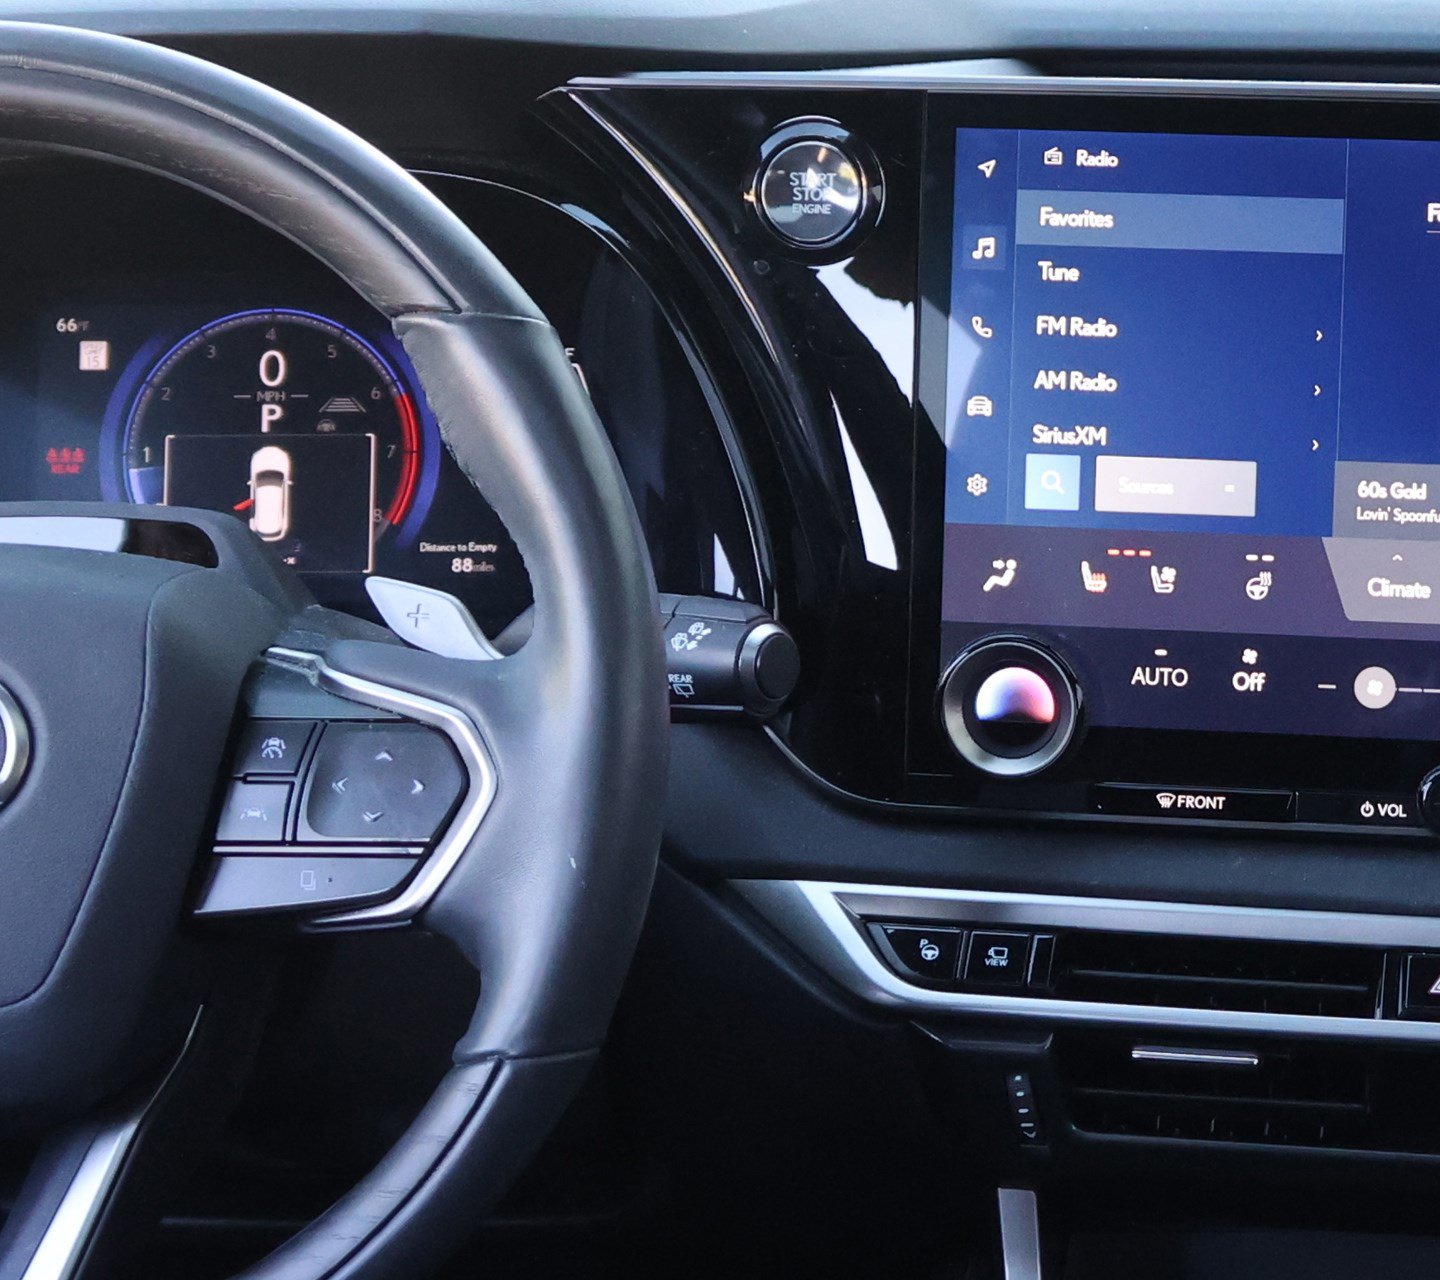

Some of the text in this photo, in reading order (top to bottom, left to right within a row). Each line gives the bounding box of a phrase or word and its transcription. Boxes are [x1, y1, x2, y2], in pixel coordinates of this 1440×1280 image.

[1076, 149, 1119, 169] Radio
[789, 171, 837, 187] STRT
[792, 203, 832, 214] ENGINE
[1039, 207, 1114, 230] Favorites
[1038, 261, 1080, 283] Tune
[265, 327, 277, 340] 4
[1036, 317, 1118, 338] FM Radio
[207, 344, 217, 359] 3
[327, 344, 337, 358] 5
[259, 349, 287, 388] 0
[1034, 371, 1118, 393] AM Radio
[161, 387, 172, 402] 2
[256, 390, 286, 403] MPH
[370, 386, 381, 400] 6
[261, 403, 284, 433] P
[1032, 425, 1107, 447] SiriusXM
[143, 446, 151, 464] 1
[387, 445, 396, 460] 7
[1357, 480, 1427, 500] 60s Gold
[419, 541, 498, 554] Distance to Empty
[451, 557, 473, 573] 88
[1367, 577, 1432, 600] Climate
[668, 673, 693, 684] REAR
[1131, 666, 1189, 688] AUTO
[1232, 671, 1267, 693] Off
[1177, 793, 1226, 811] FRONT
[1378, 801, 1408, 819] VOL
[984, 958, 1008, 967] VIEW
